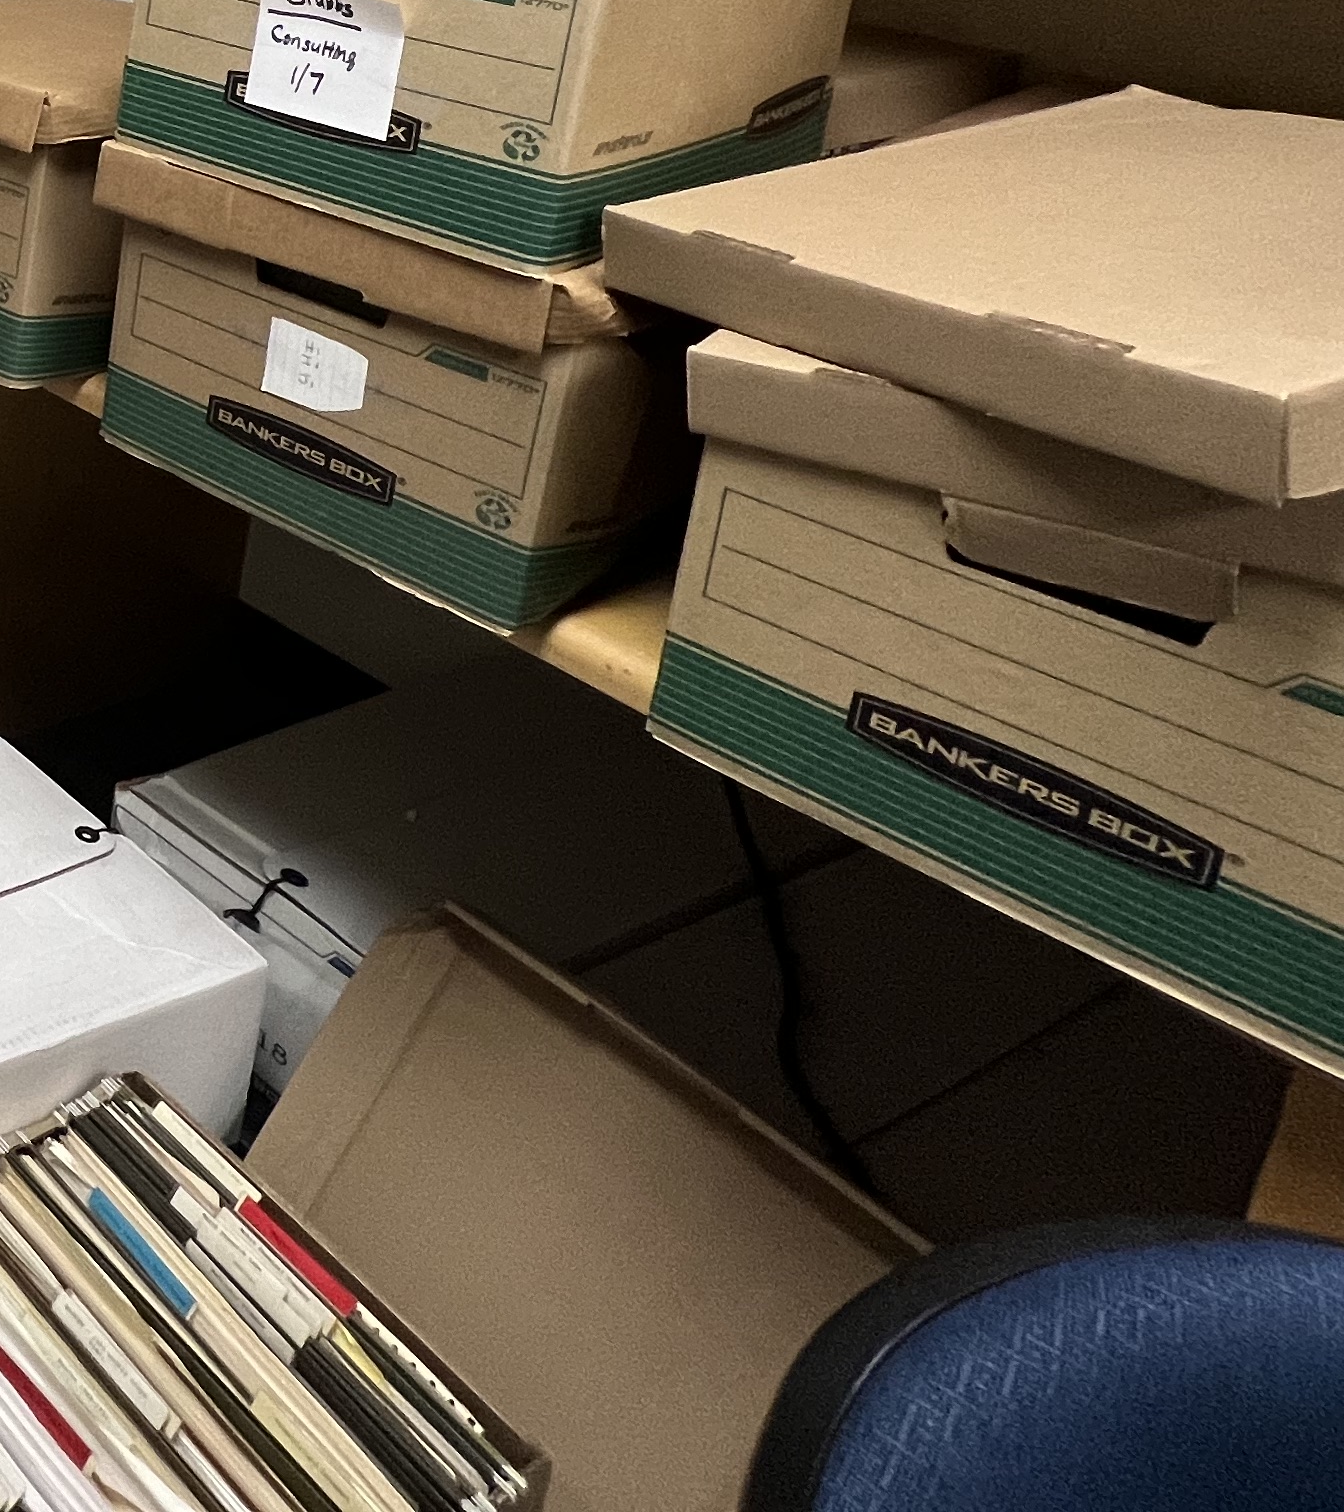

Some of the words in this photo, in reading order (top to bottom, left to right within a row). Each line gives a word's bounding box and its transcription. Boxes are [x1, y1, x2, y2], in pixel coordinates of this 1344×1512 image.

[291, 63, 325, 95] 1/7
[218, 407, 326, 467] BANKERS
[329, 457, 383, 493] BOX
[869, 711, 1080, 816] BANKERS
[1088, 807, 1196, 869] BOX
